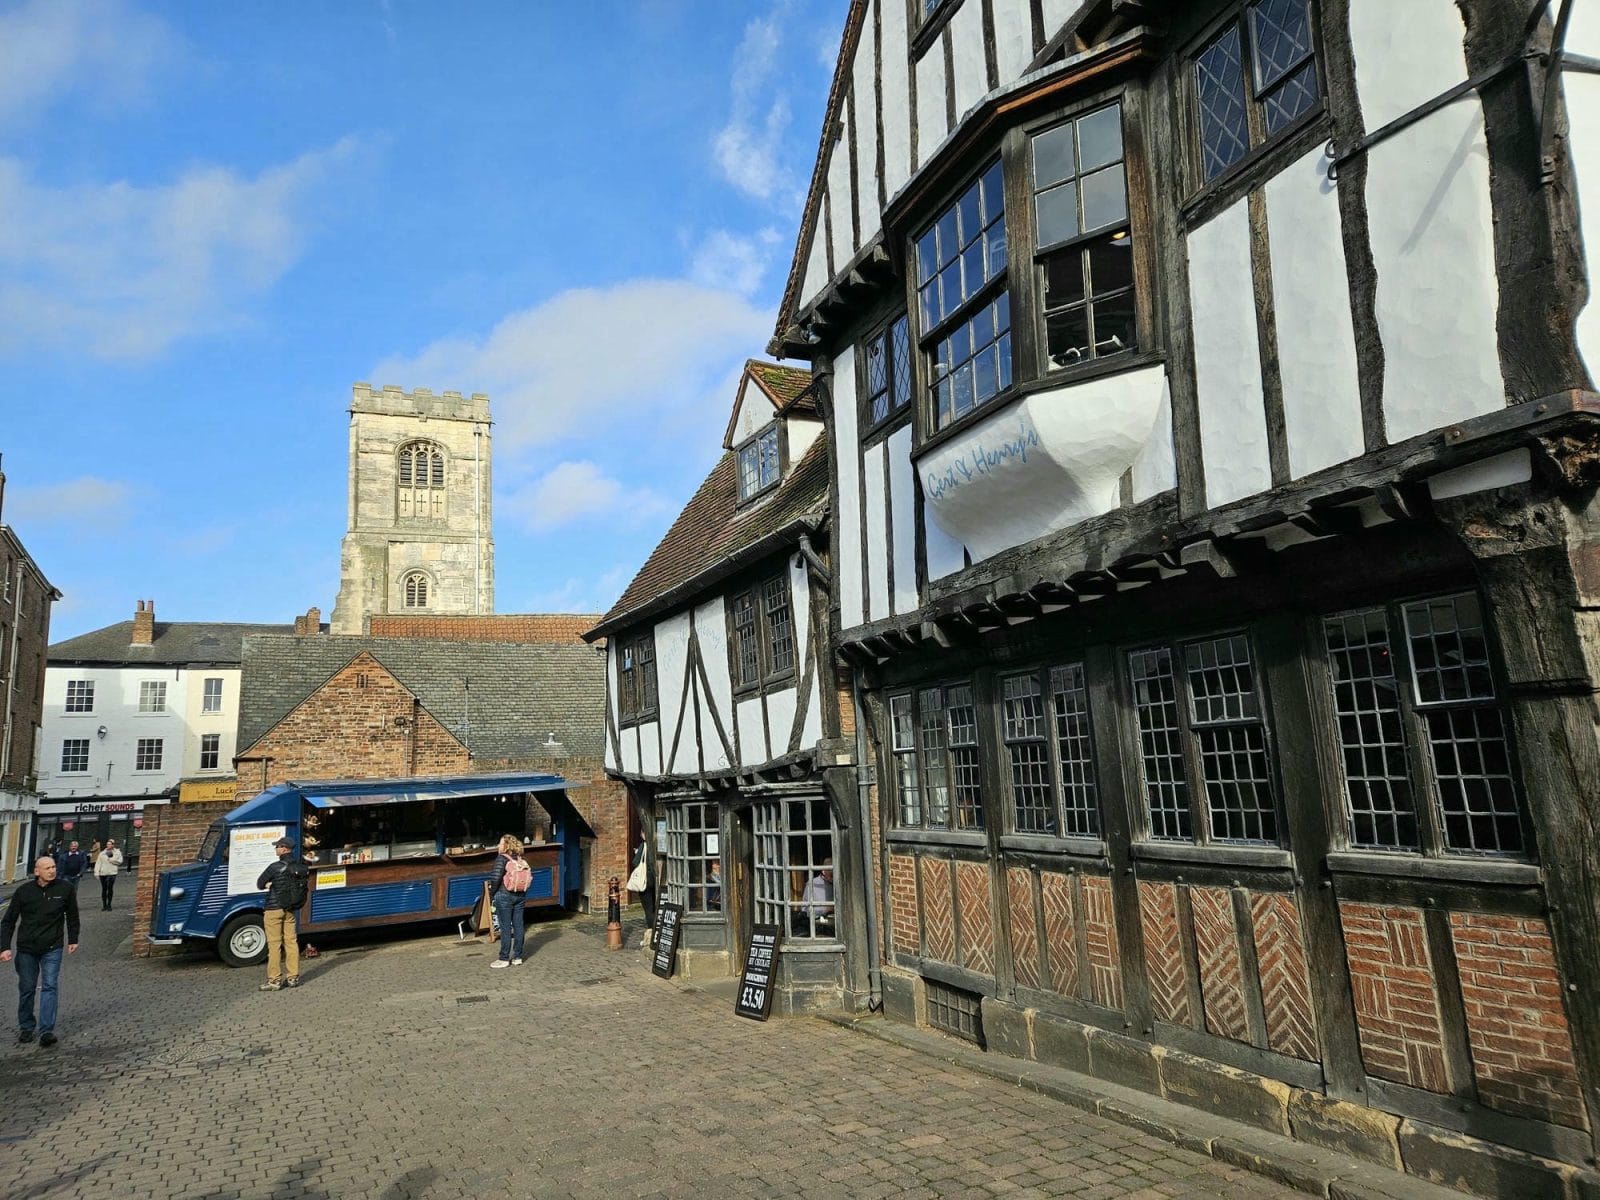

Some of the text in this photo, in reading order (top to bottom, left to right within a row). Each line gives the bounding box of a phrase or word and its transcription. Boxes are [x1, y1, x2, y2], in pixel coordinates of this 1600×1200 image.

[927, 466, 959, 499] Gert
[972, 423, 1038, 474] Henry's
[215, 786, 236, 795] Luck
[75, 803, 135, 812] richer SOUNDS
[741, 986, 765, 1010] £3.50
